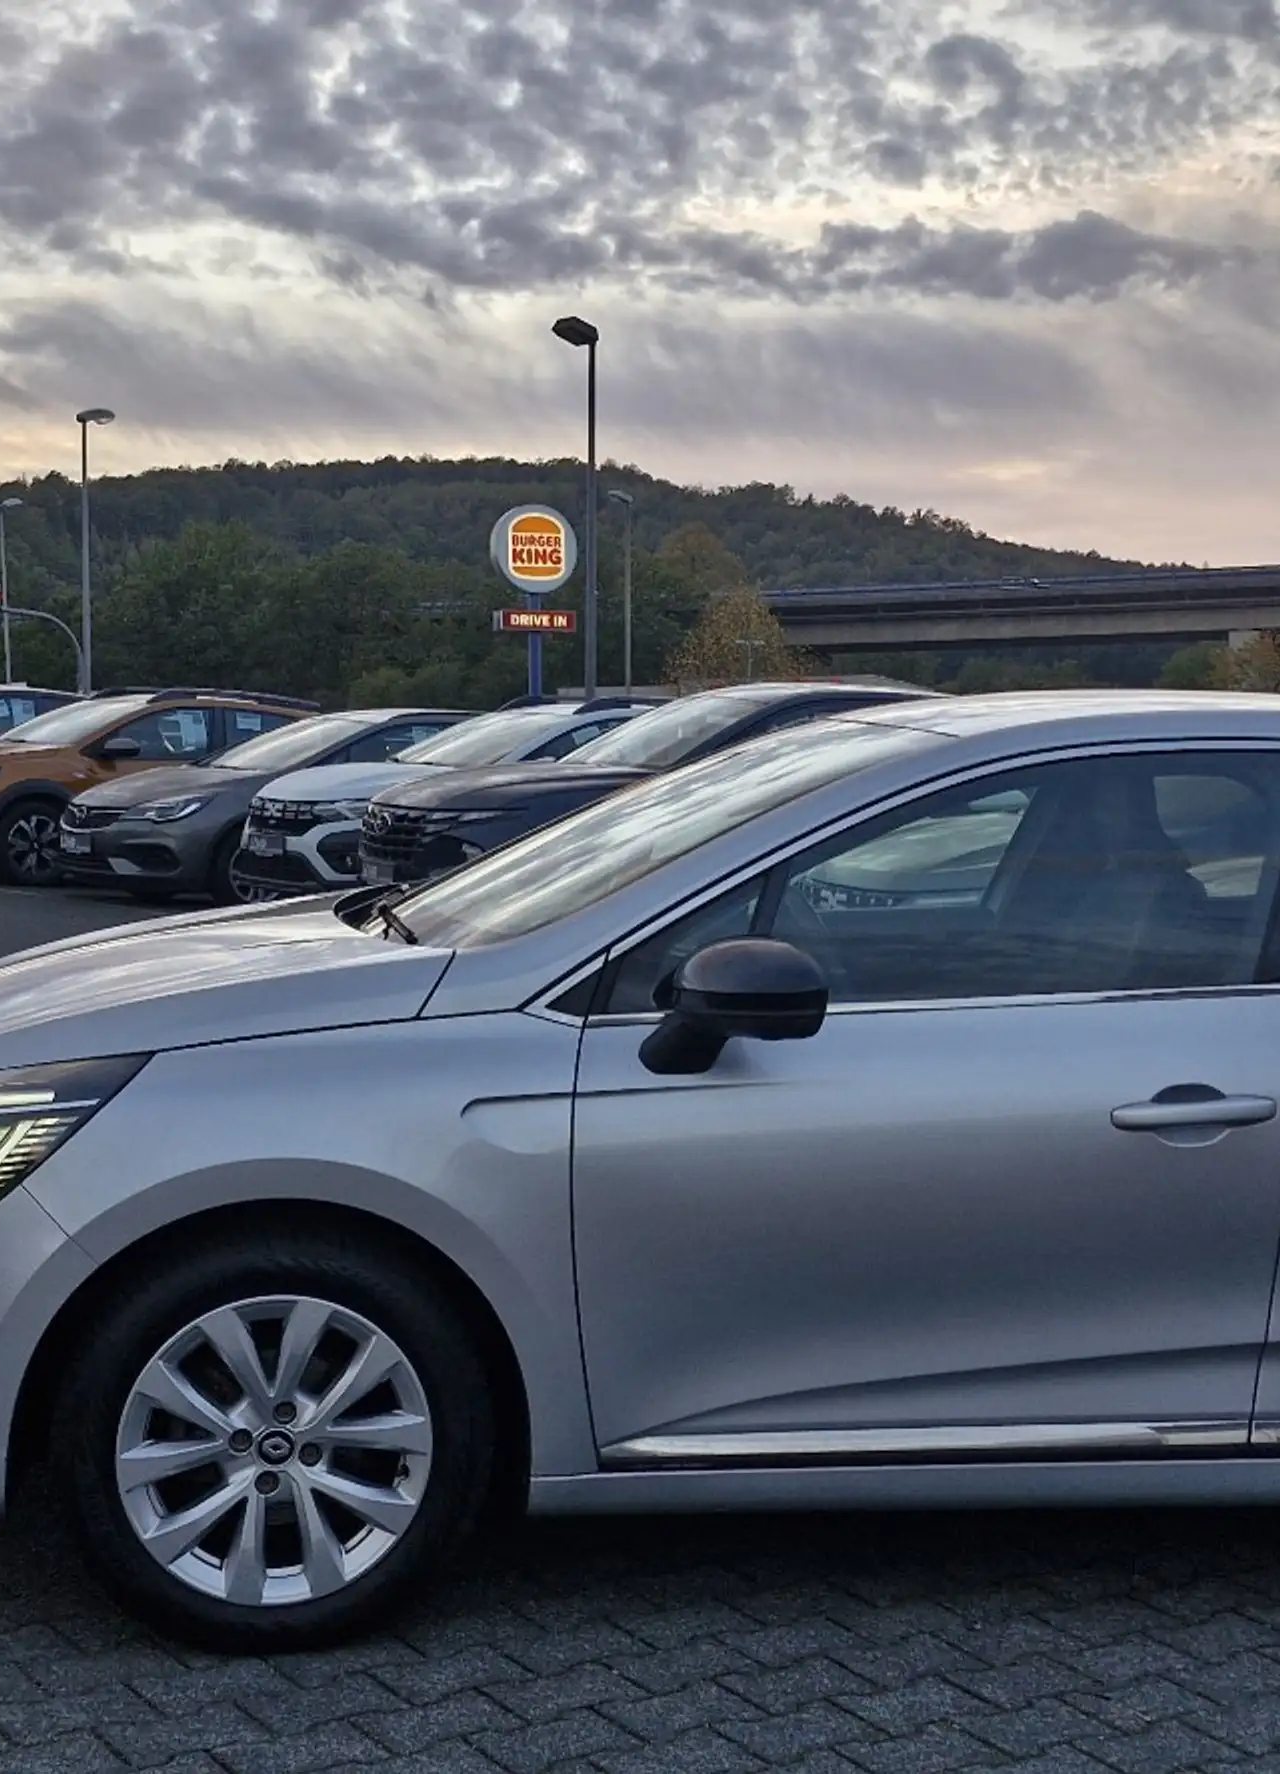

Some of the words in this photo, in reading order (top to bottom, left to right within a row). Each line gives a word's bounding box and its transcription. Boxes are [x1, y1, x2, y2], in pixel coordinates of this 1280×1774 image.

[512, 534, 562, 547] BURGER
[512, 548, 563, 565] KING
[510, 614, 551, 627] DRIVE
[554, 615, 567, 628] IN
